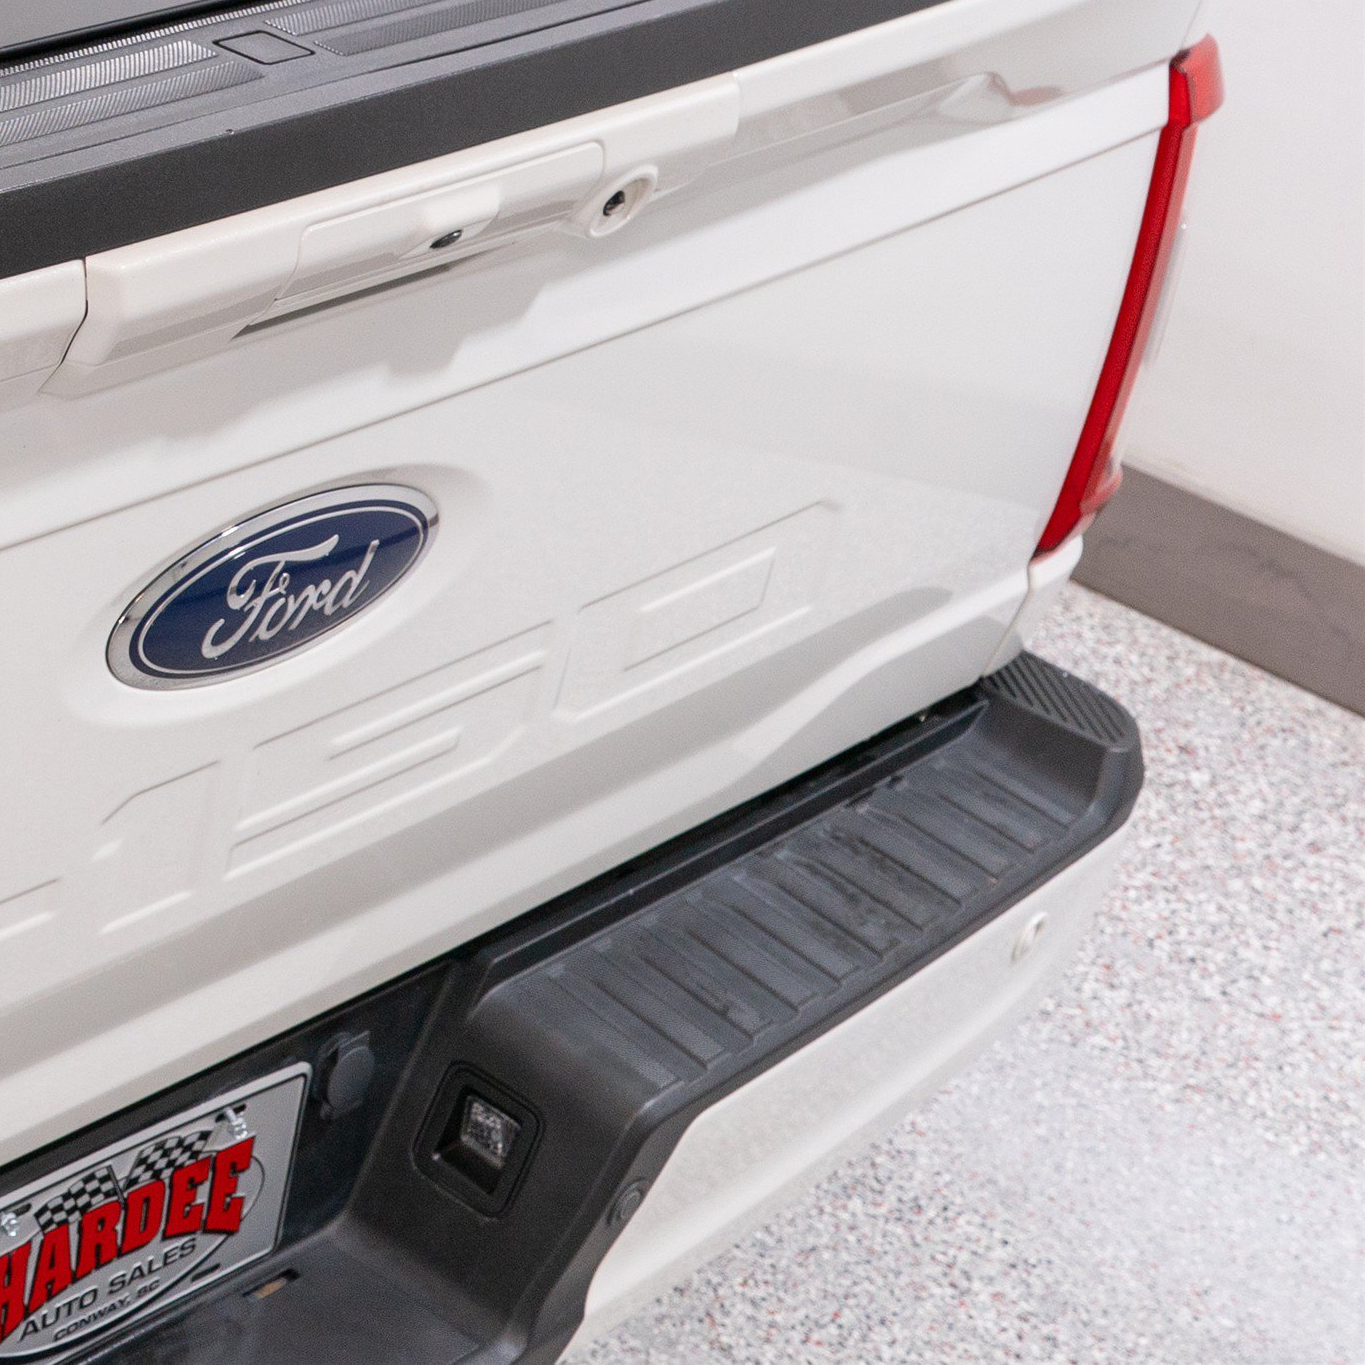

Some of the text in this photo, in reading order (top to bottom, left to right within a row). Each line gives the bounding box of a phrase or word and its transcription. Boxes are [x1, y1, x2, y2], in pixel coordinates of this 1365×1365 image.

[201, 534, 380, 660] Ford
[18, 1237, 197, 1342] AUTO SALES
